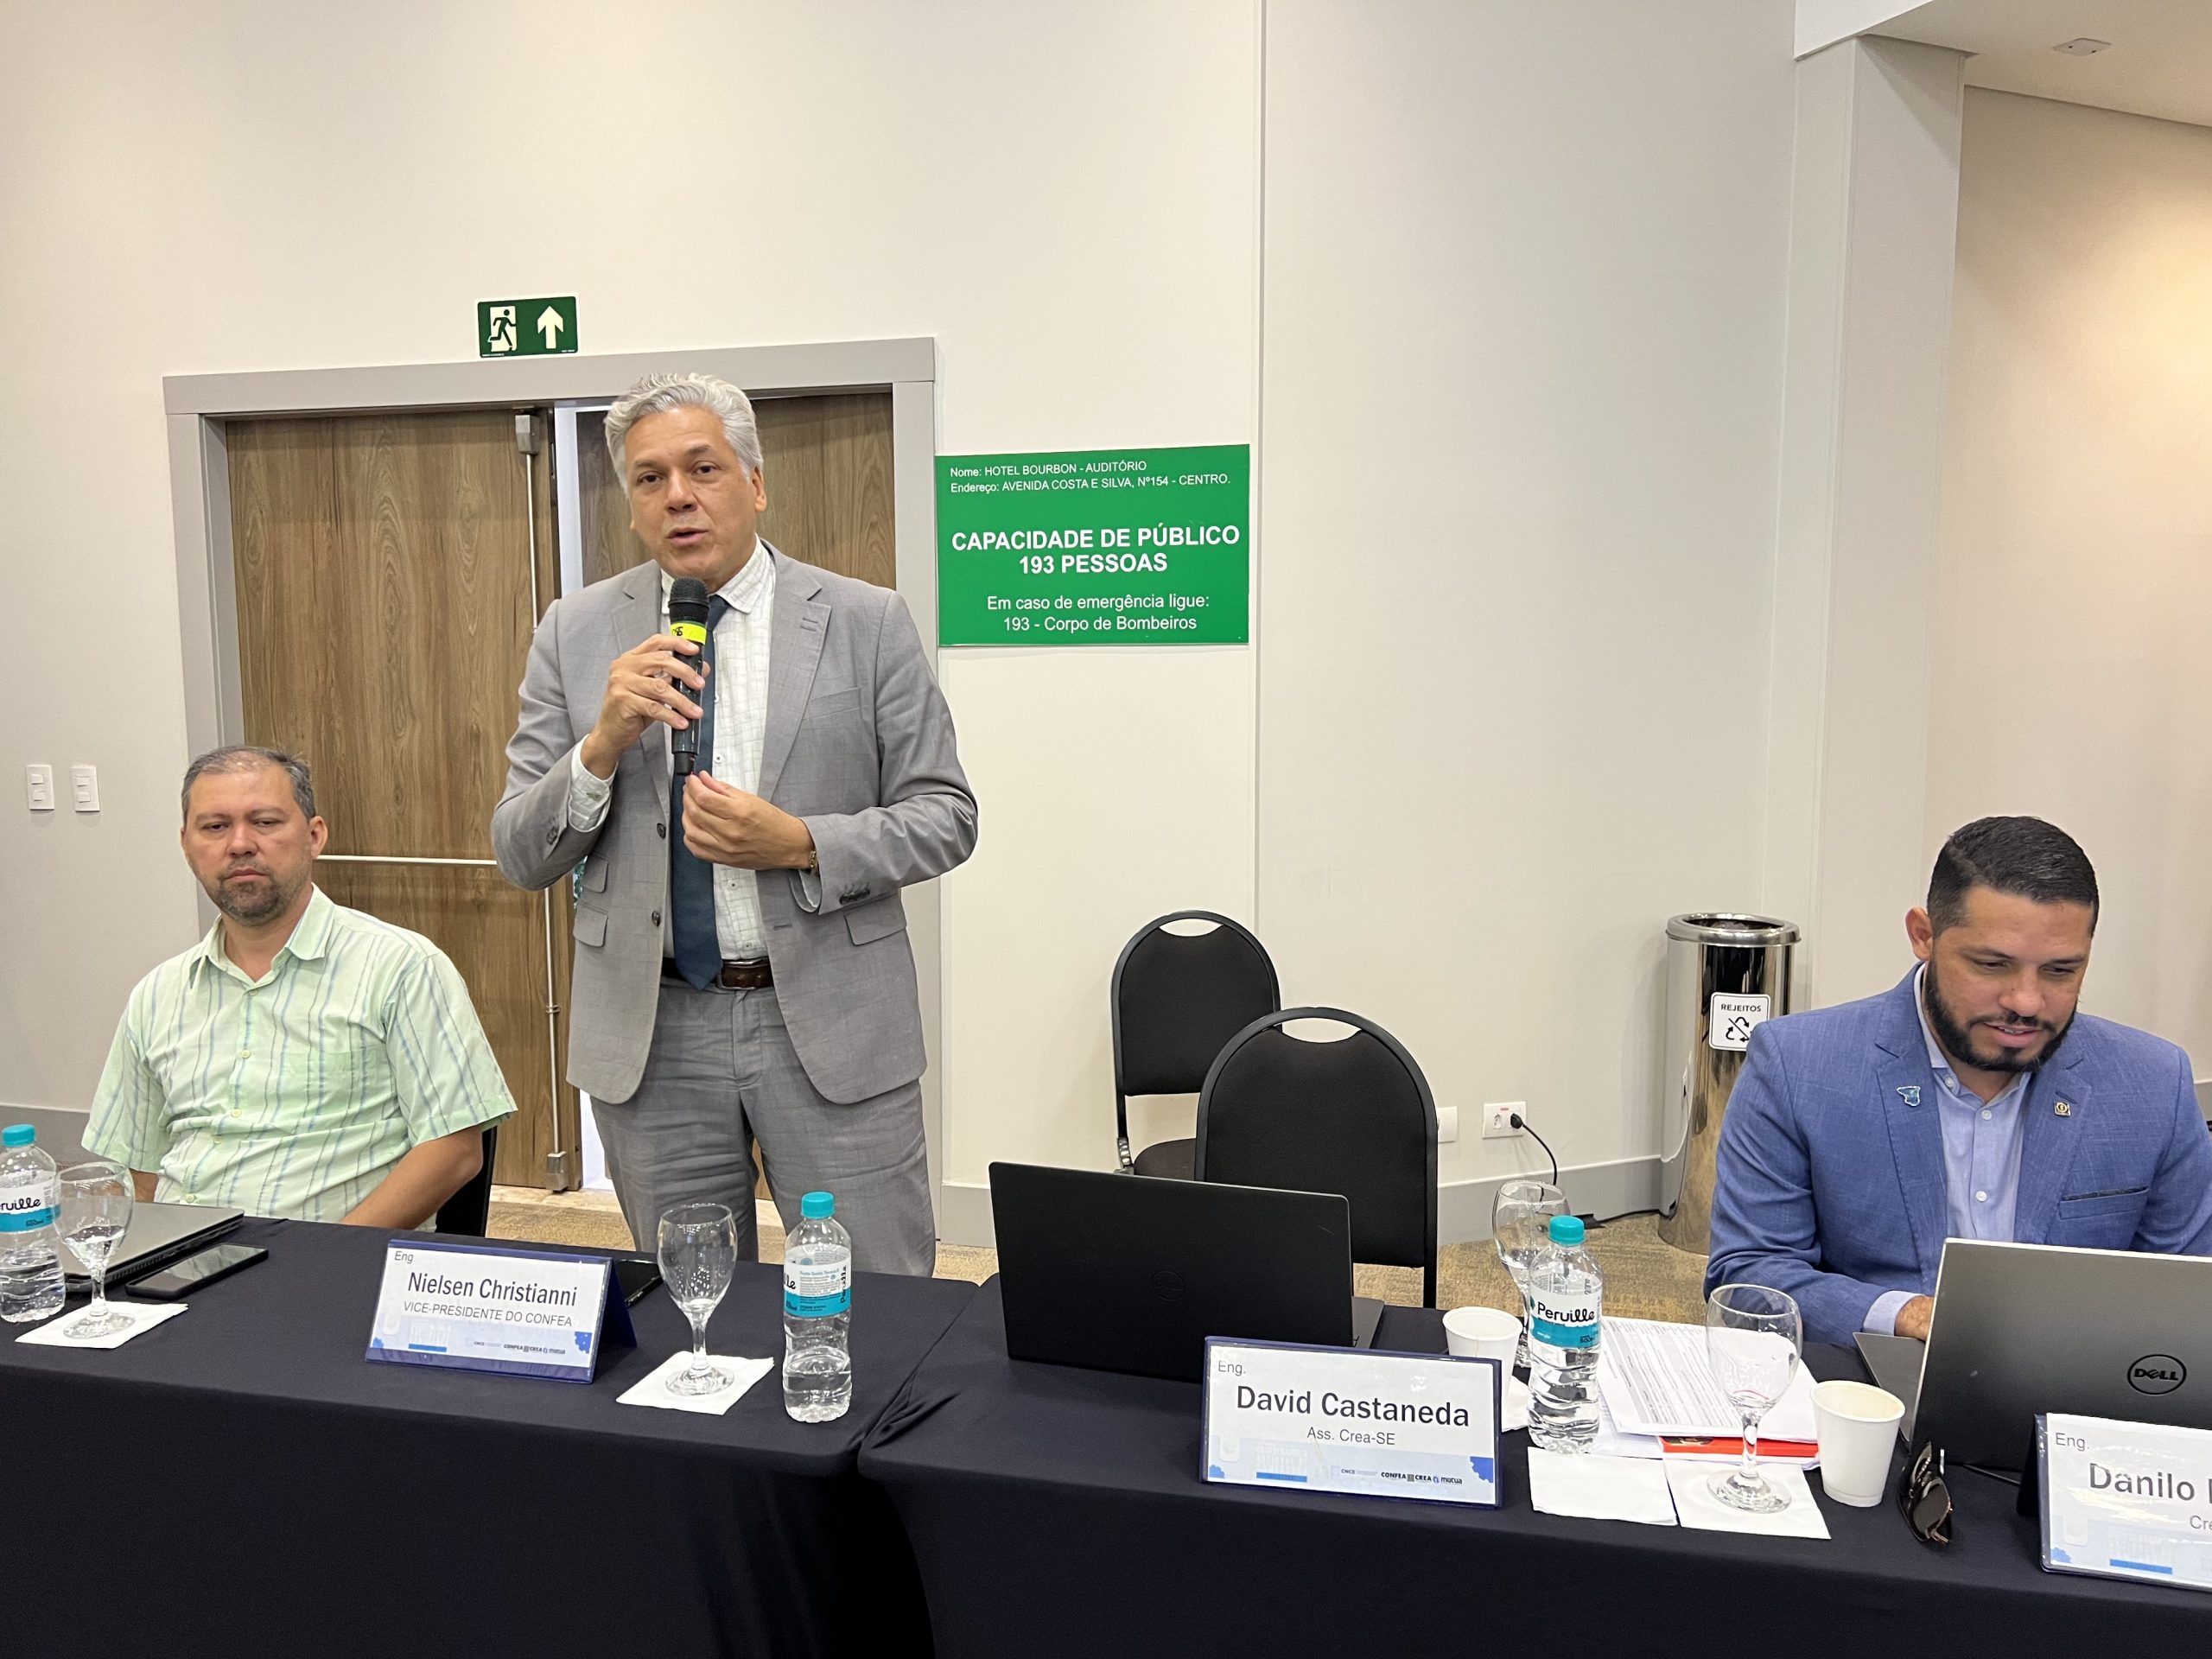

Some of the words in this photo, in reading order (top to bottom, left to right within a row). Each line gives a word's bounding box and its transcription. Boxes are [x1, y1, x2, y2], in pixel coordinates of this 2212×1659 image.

[950, 467, 981, 477] Nome:
[985, 466, 1020, 475] HOTEL
[1023, 464, 1076, 474] BOURBON
[1084, 459, 1147, 473] AUDITÓRIO
[951, 483, 999, 493] Endereço:
[1002, 480, 1049, 491] AVENIDA
[1052, 480, 1089, 489] COSTA
[1091, 479, 1097, 488] E
[1102, 478, 1134, 488] SILVA,
[1138, 476, 1168, 486] Nº154
[1179, 473, 1230, 486] CENTRO.
[951, 529, 1094, 551] CAPACIDADE
[1100, 528, 1131, 548] DE
[1137, 522, 1240, 547] PÚBLICO
[1019, 555, 1055, 575] 193
[1061, 552, 1168, 574] PESSOAS
[987, 595, 1012, 610] Em
[1016, 599, 1050, 609] caso
[1054, 594, 1073, 609] de
[1077, 594, 1165, 613] emergência
[1169, 593, 1210, 612] ligue:
[1003, 616, 1030, 632] 193
[1044, 616, 1090, 634] Corpo
[1093, 616, 1112, 631] de
[1116, 615, 1198, 630] Bombeiros
[408, 1272, 474, 1297] Nielsen
[480, 1278, 577, 1306] Christianni
[404, 1301, 503, 1320] VICE-PRESIDENTE
[505, 1311, 522, 1321] DO
[525, 1313, 572, 1327] CONFEA
[1217, 1360, 1246, 1377] Eng.
[2133, 1369, 2178, 1381] DELL
[1237, 1385, 1311, 1414] David
[1321, 1392, 1469, 1427] Castaneda
[1306, 1427, 1335, 1440] Ass.
[1339, 1428, 1395, 1446] Crea-SE
[2055, 1432, 2089, 1452] Eng.
[2089, 1463, 2196, 1502] Danilo
[2190, 1515, 2212, 1530] Cre
